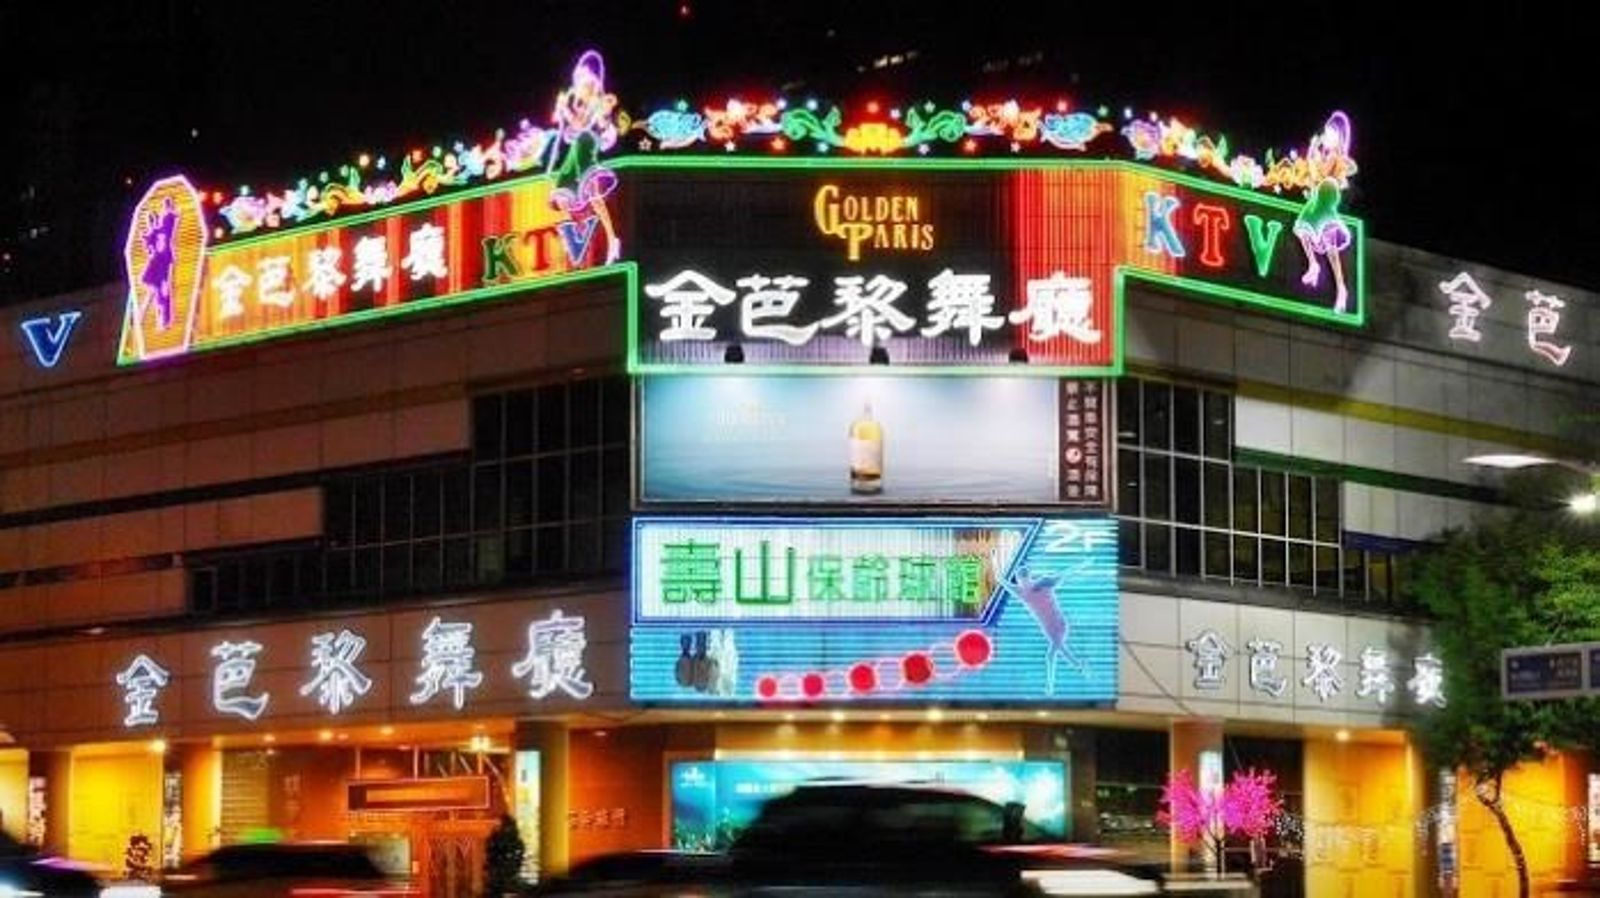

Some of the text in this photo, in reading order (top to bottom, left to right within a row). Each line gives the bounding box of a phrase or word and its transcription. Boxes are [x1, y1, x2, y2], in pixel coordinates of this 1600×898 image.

[814, 184, 919, 236] GOLDEN
[839, 222, 935, 261] PARIS
[1143, 191, 1283, 278] KTV
[481, 214, 600, 287] KTV
[20, 311, 81, 368] V
[644, 267, 1102, 348] 金芭黎舞廳
[1439, 271, 1573, 367] 金芭
[1043, 522, 1115, 553] 2F
[116, 608, 595, 728] 金芭黎舞廳
